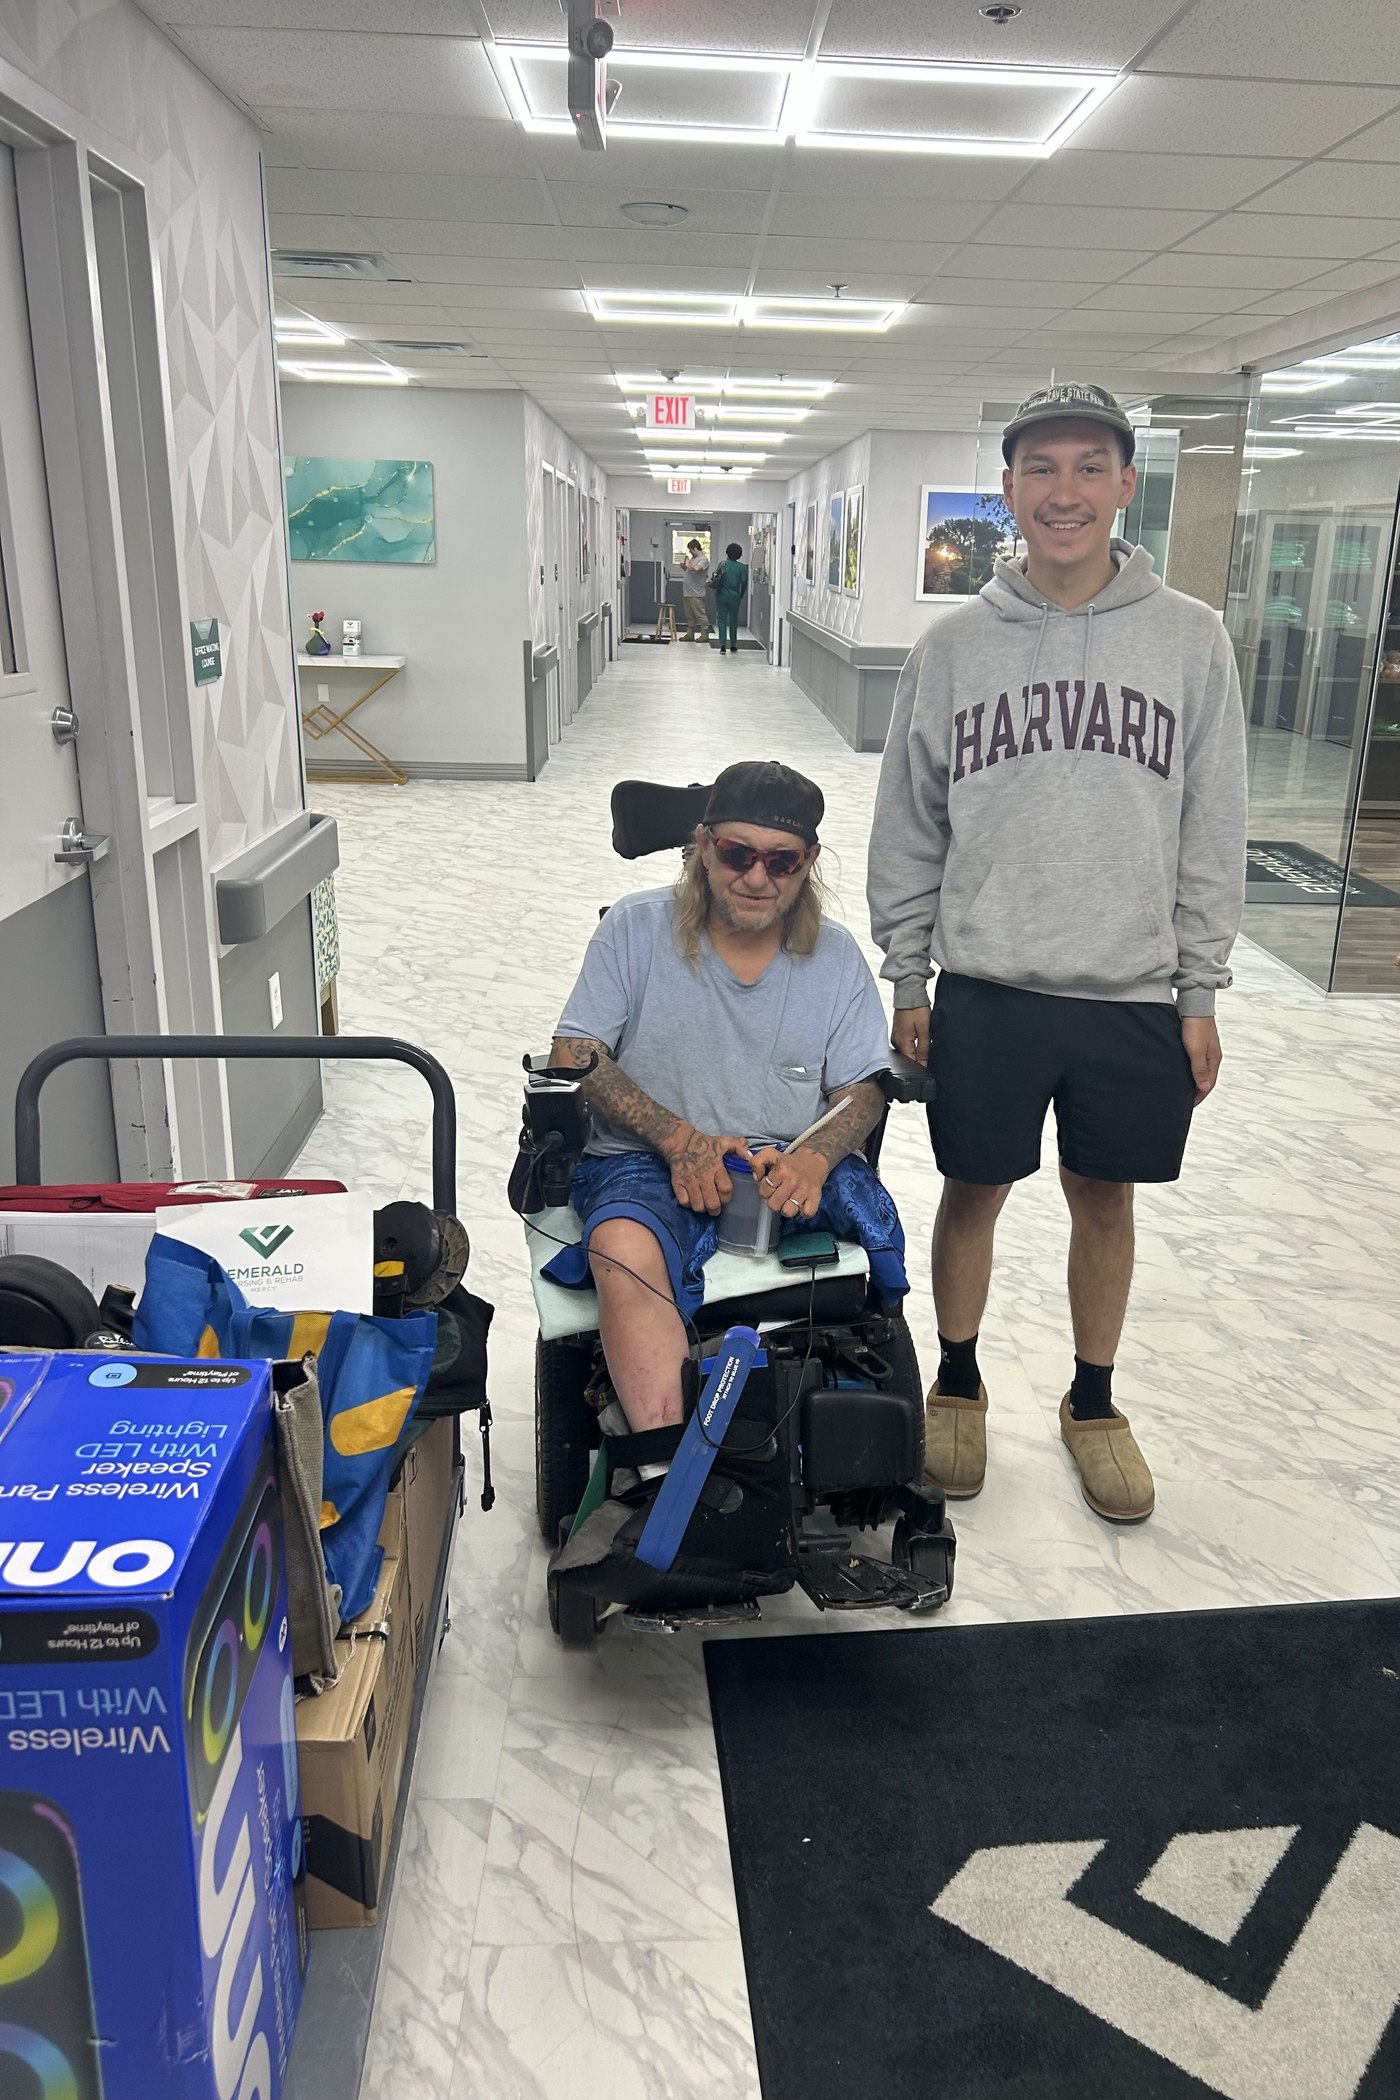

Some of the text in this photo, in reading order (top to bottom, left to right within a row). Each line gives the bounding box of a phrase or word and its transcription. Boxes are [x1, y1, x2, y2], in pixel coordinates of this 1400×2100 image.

[1067, 387, 1089, 401] STATE
[655, 396, 689, 425] EXIT
[671, 479, 688, 493] EXIT
[953, 680, 1176, 784] HARVARD
[227, 1263, 304, 1280] EMERALD
[235, 1279, 264, 1287] RSING
[275, 1275, 304, 1283] REHAB
[704, 1356, 734, 1426] FOOT DROP PROTECTION
[109, 1420, 229, 1439] Lighting
[75, 1443, 218, 1458] With LED
[81, 1458, 212, 1478] Speaker
[0, 1482, 200, 1501] Wireless Par
[0, 1539, 175, 1588] on
[125, 1621, 140, 1632] of
[47, 1636, 142, 1650] Up to 12 Hours
[77, 1686, 168, 1718] With
[8, 1725, 171, 1756] Wireless
[256, 1760, 274, 1890] Speaker
